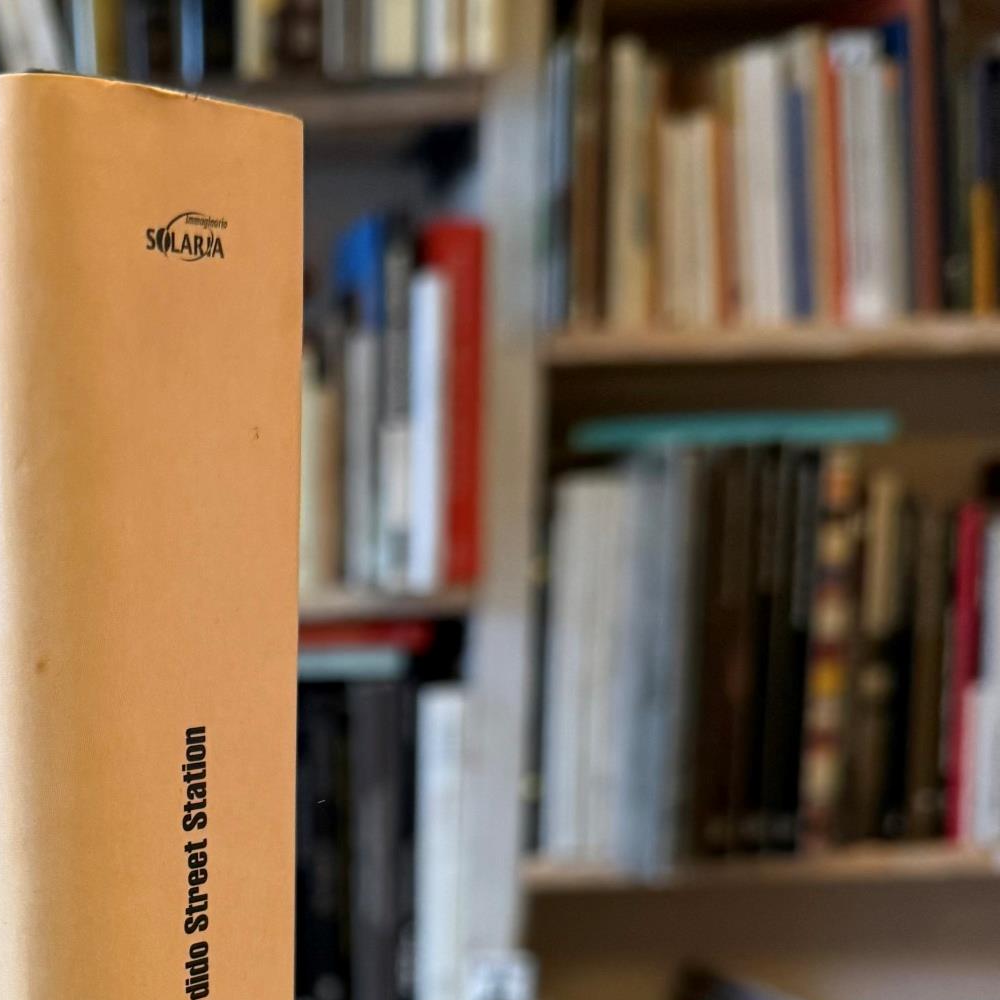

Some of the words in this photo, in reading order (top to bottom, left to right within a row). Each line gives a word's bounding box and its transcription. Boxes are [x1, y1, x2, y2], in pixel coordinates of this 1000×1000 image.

[146, 228, 224, 259] SOLARIA
[182, 725, 207, 832] Station
[184, 838, 209, 934] Street
